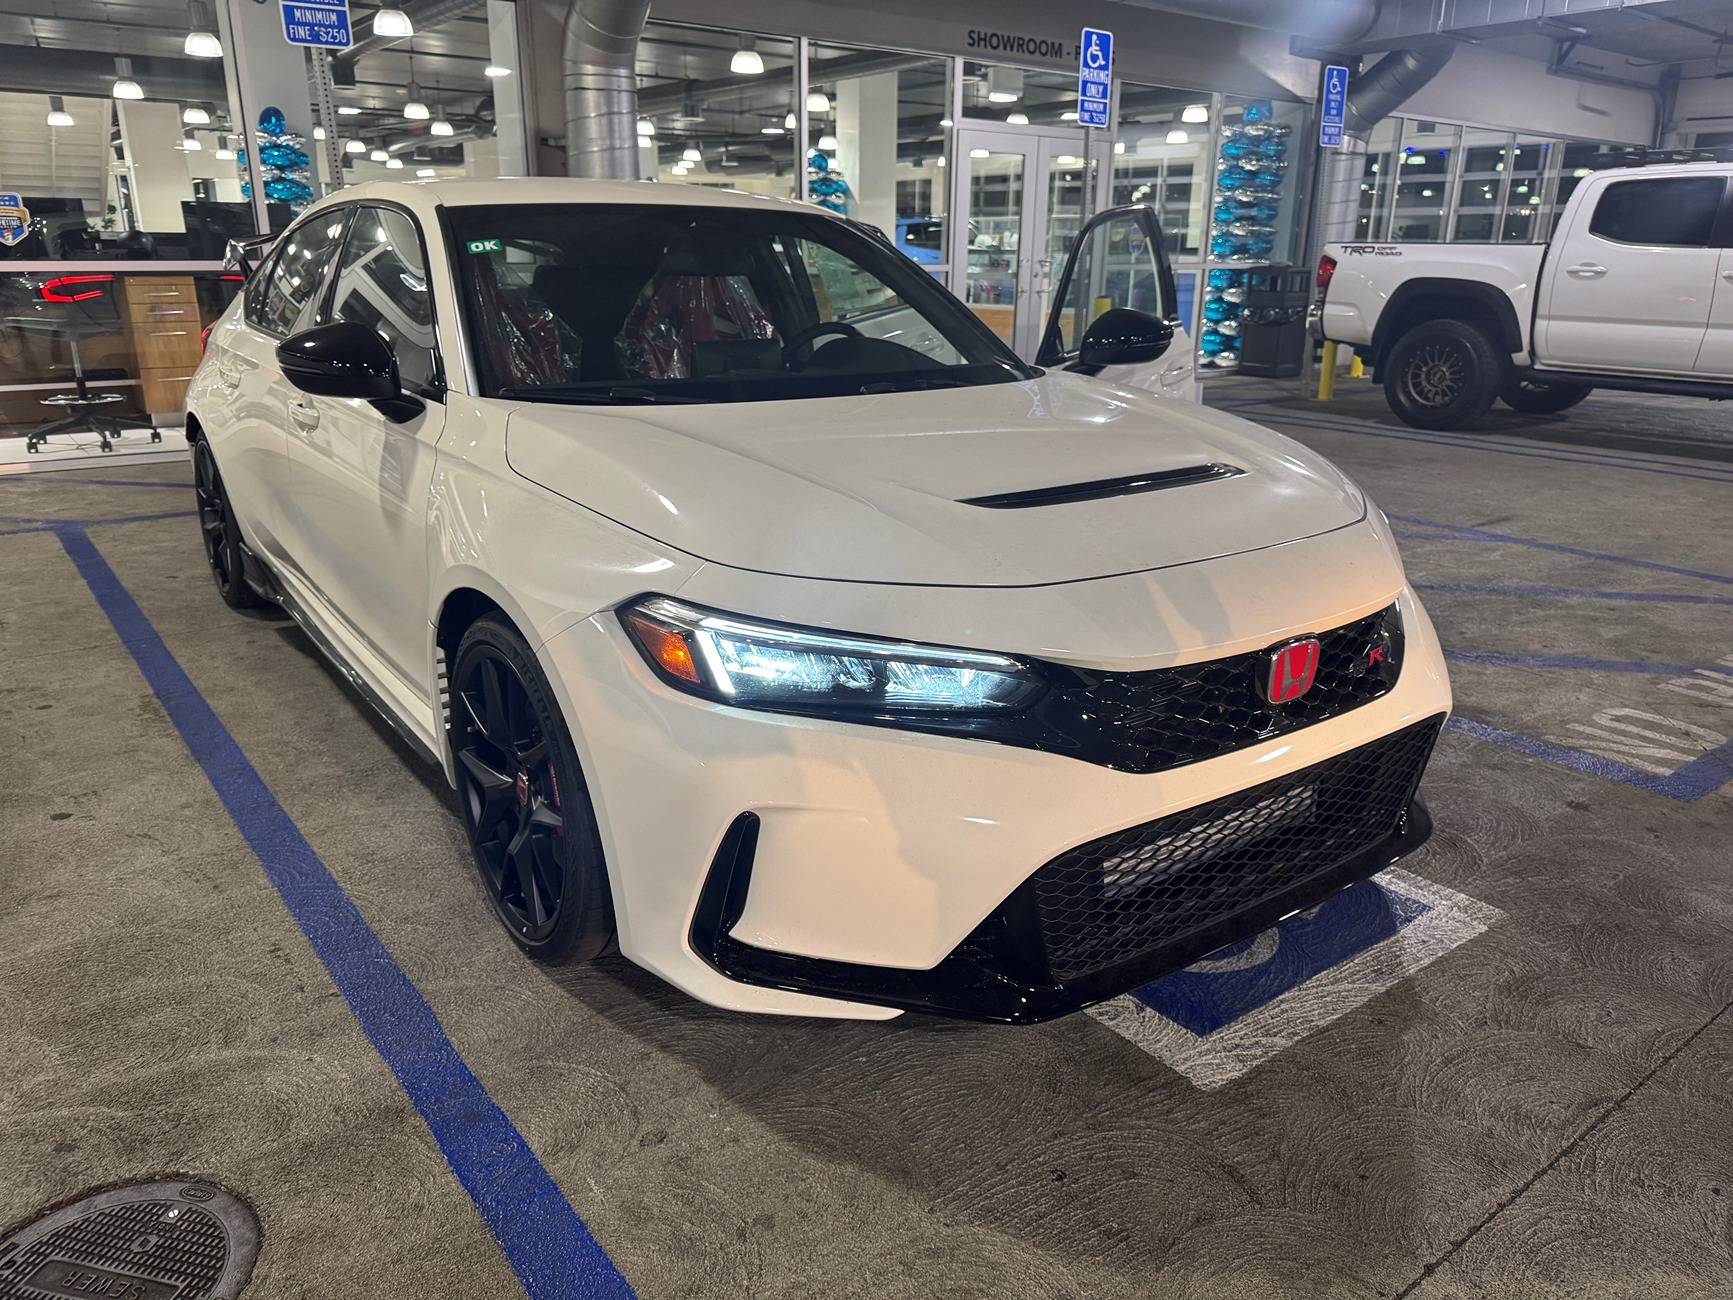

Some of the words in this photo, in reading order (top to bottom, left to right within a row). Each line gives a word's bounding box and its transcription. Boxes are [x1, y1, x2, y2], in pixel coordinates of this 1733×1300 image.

[293, 8, 338, 26] MINIMUM
[288, 24, 312, 40] FINE
[319, 27, 347, 43] $250
[967, 29, 1063, 59] SHOWROOM
[1081, 67, 1109, 84] PARKING
[1086, 82, 1104, 98] ONLY
[470, 240, 499, 252] OK
[1542, 707, 1728, 776] NO
[62, 1270, 146, 1300] SEWER
